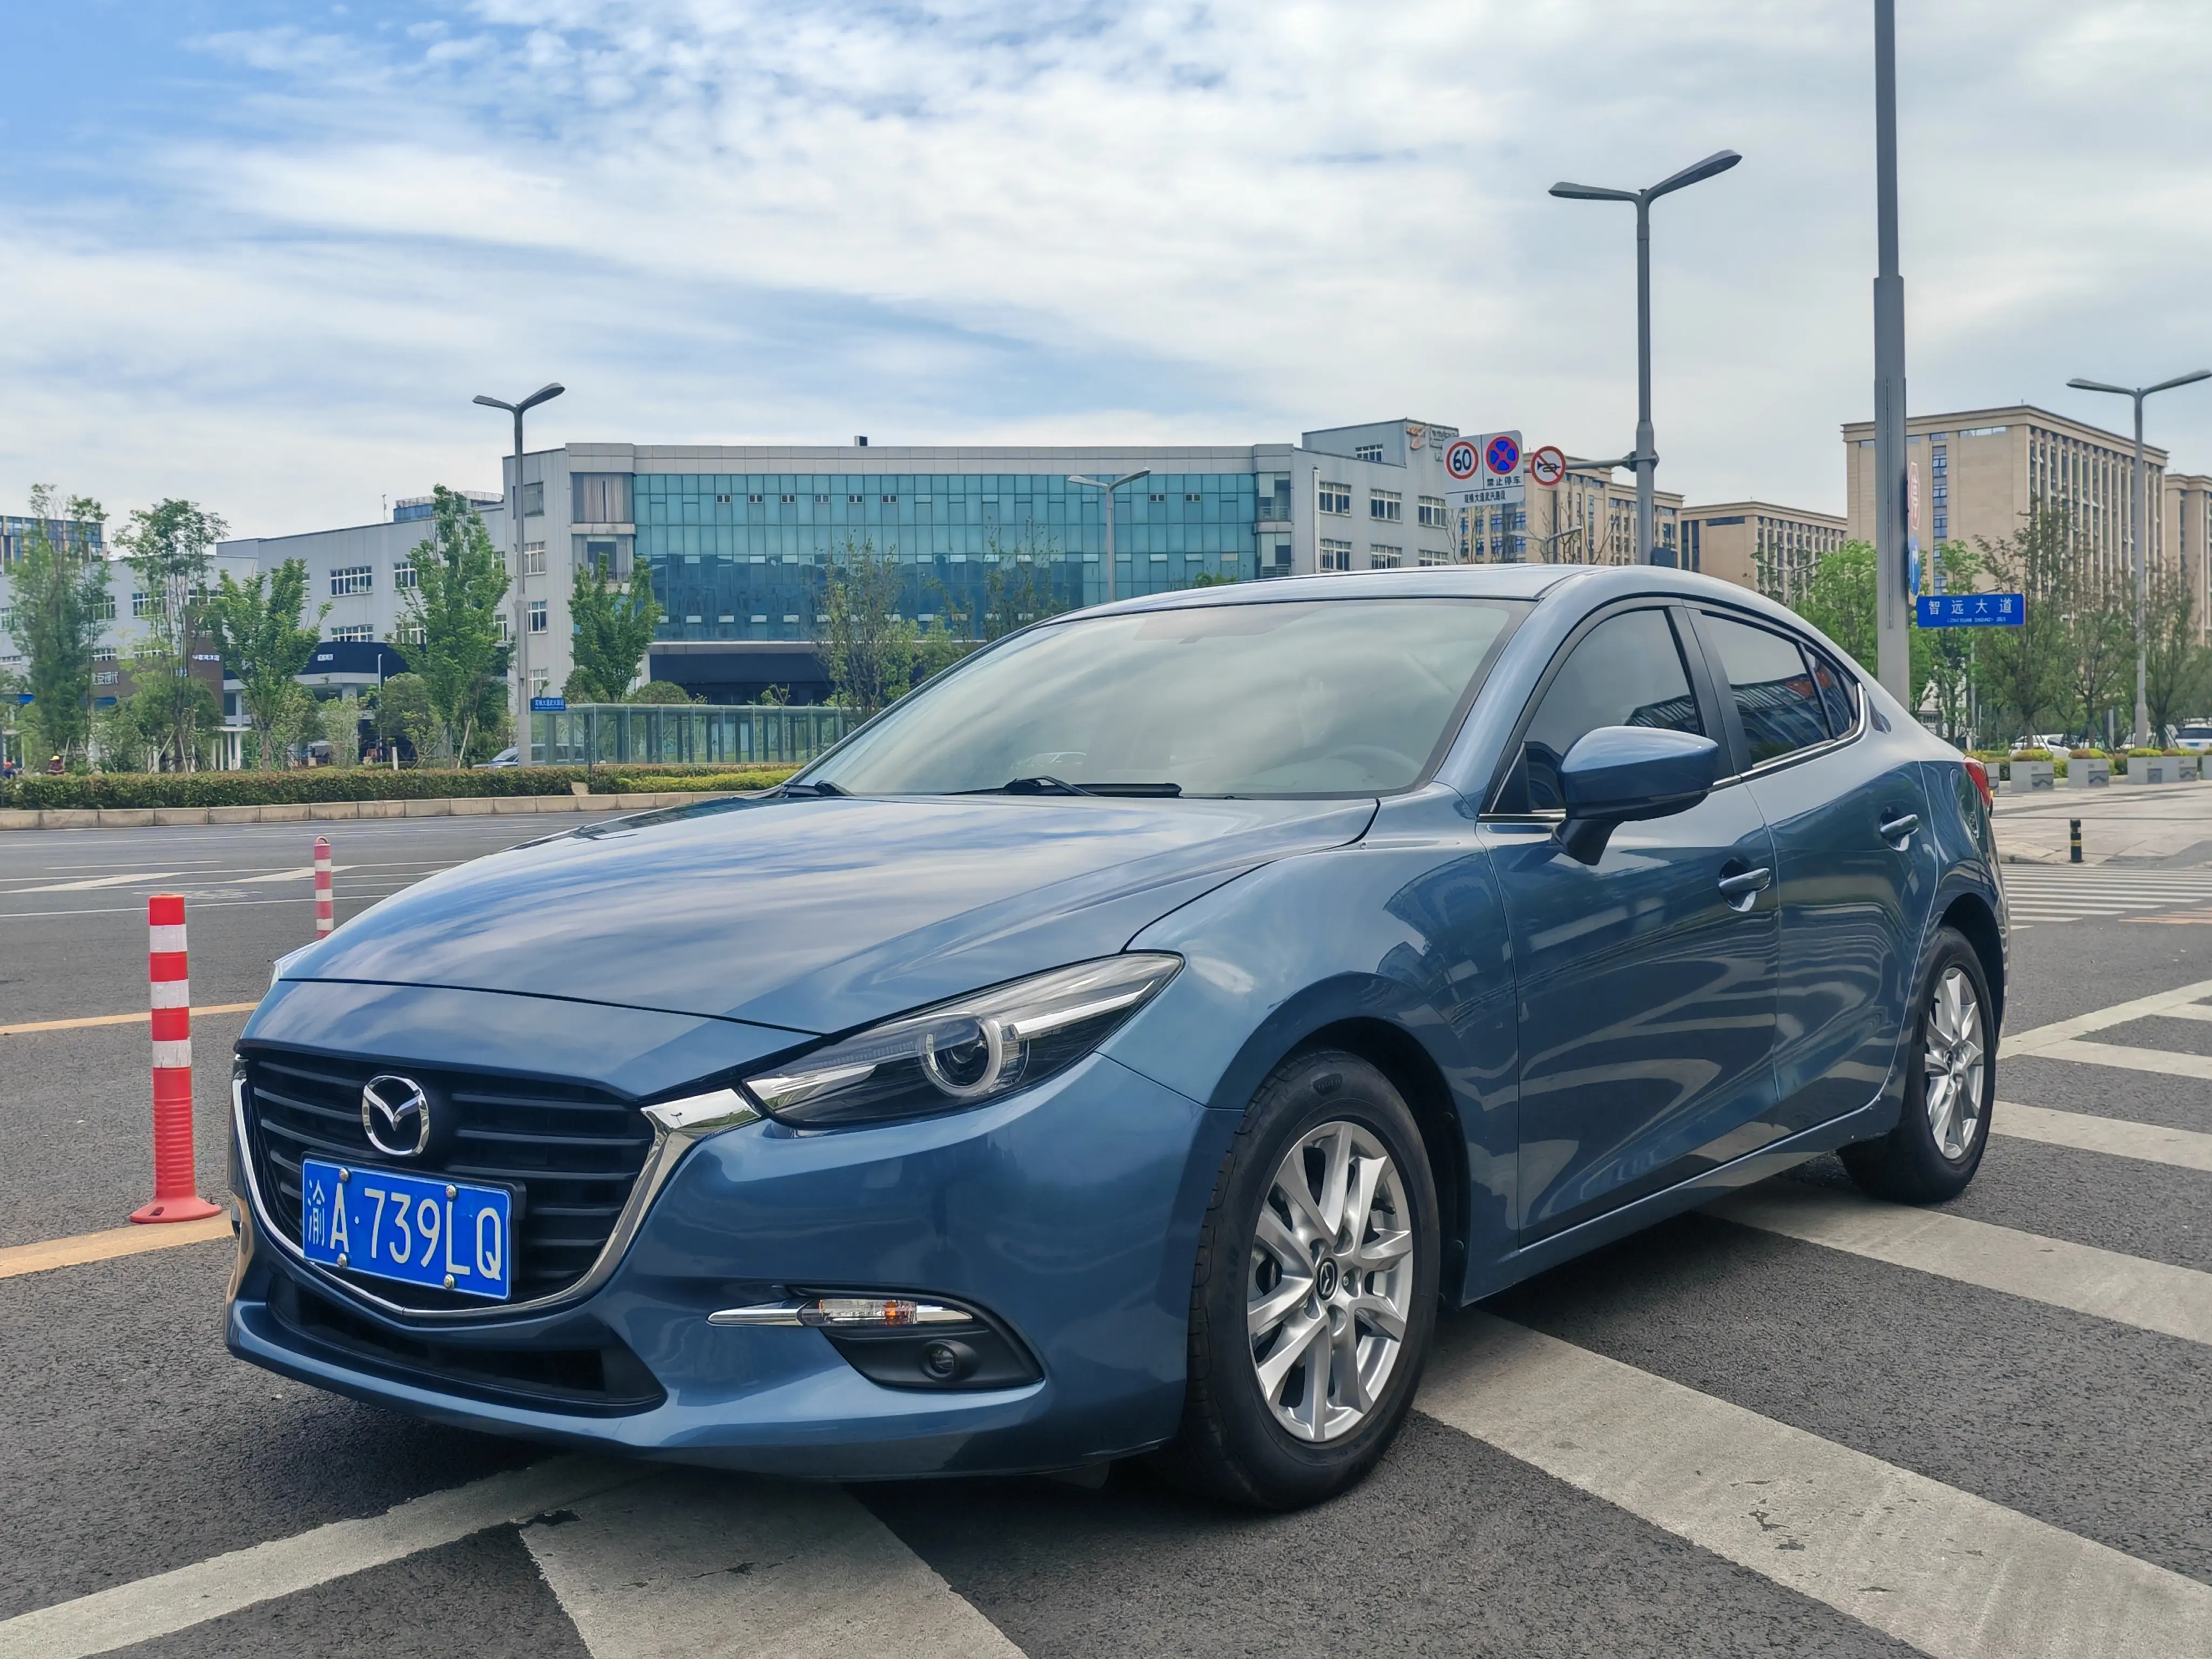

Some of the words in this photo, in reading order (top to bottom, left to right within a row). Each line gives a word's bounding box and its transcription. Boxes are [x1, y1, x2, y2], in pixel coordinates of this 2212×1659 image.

[1453, 449, 1472, 471] 60
[1487, 476, 1521, 486] 禁止停车
[1928, 598, 2012, 615] 智远大道
